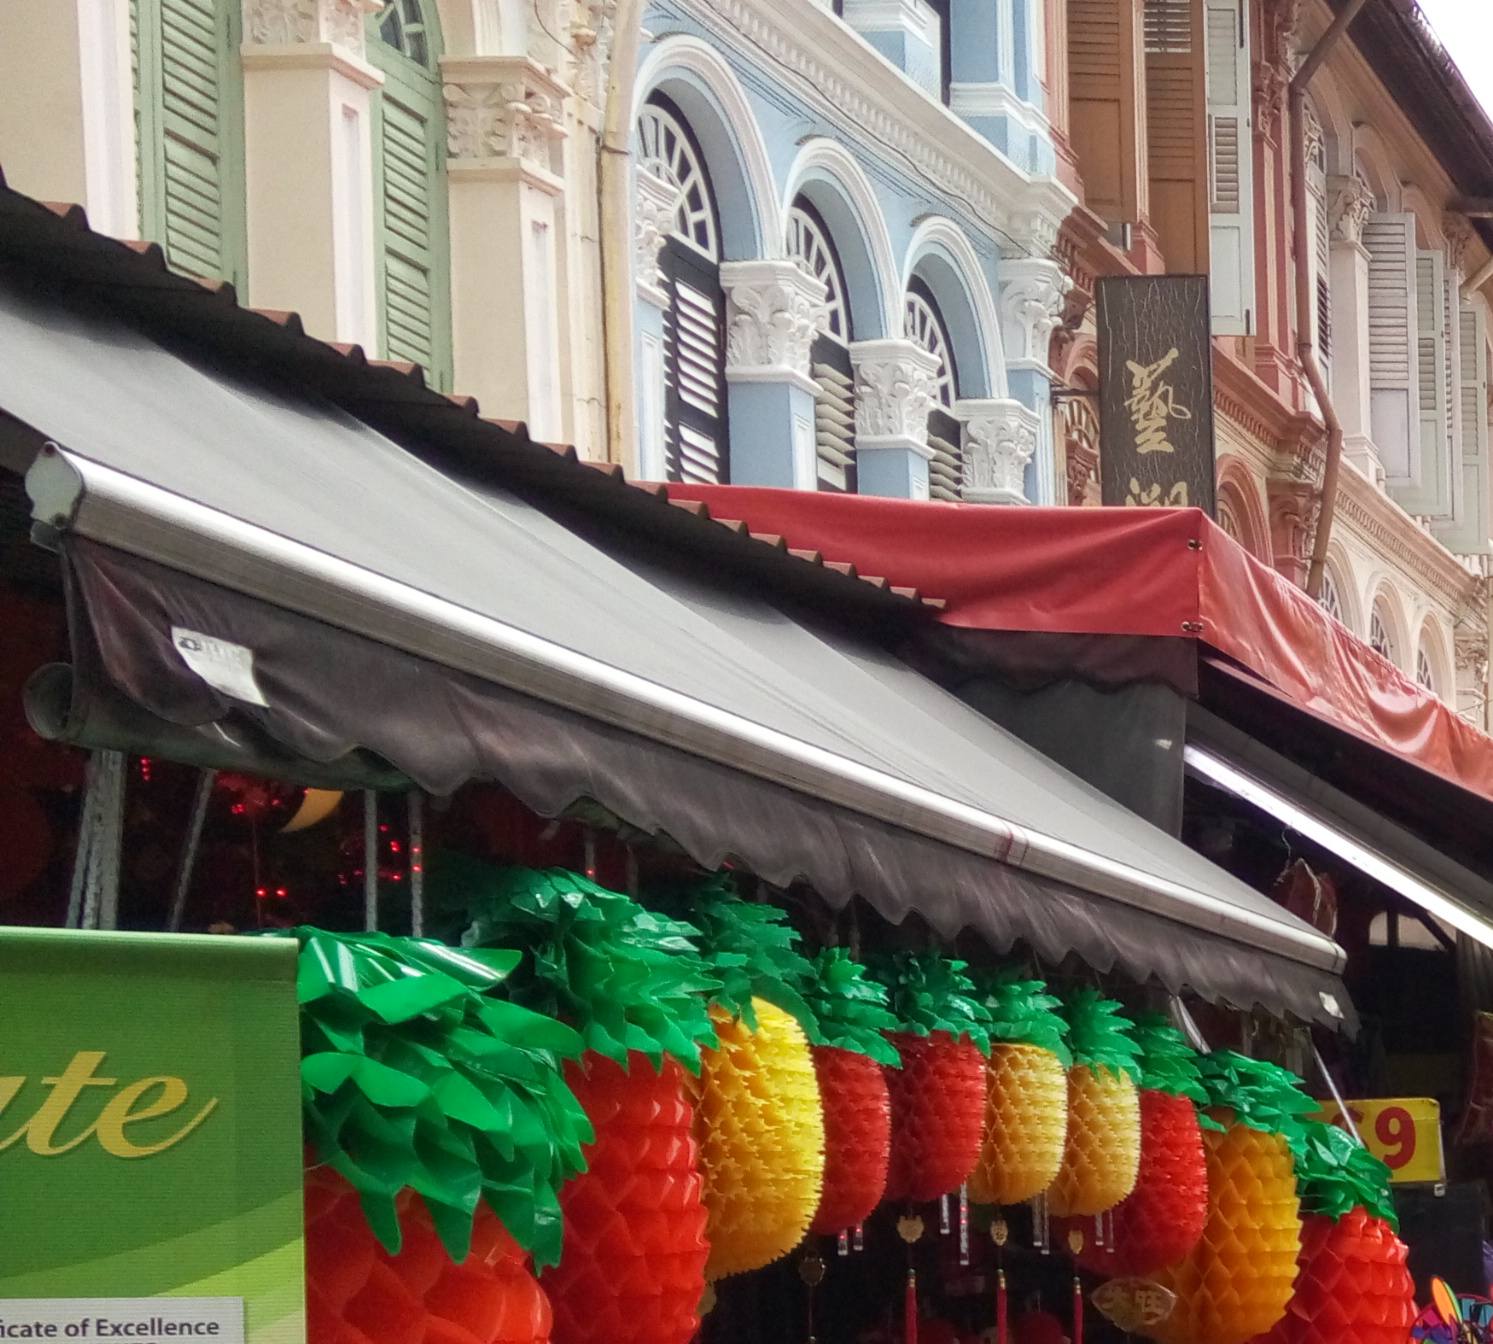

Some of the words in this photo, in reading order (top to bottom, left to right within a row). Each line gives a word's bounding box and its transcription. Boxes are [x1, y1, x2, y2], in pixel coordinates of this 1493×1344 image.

[0, 1050, 217, 1158] te
[65, 1318, 90, 1337] of
[96, 1317, 220, 1336] Excellence
